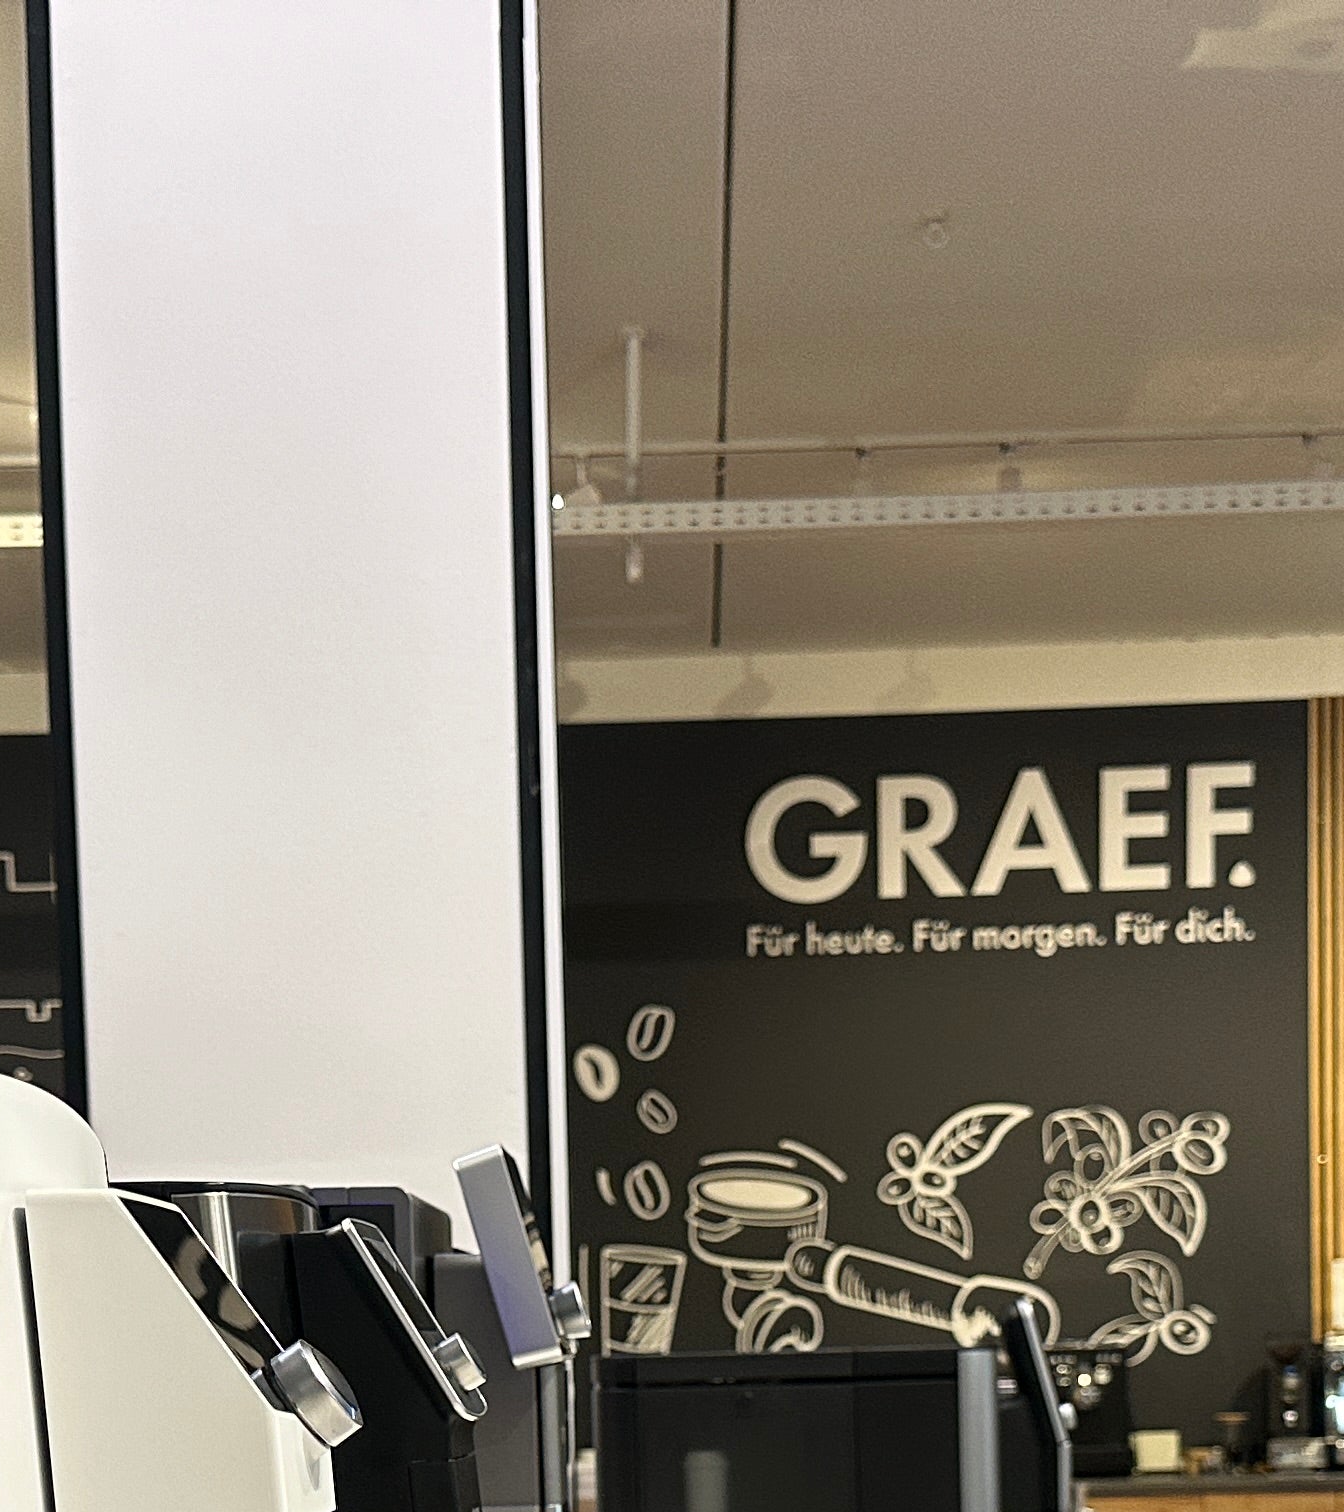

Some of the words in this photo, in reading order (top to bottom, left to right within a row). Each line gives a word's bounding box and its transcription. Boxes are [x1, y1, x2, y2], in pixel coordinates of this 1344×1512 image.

[745, 761, 1256, 904] GRAEF.
[746, 922, 800, 957] Für
[806, 919, 904, 955] heute.
[912, 918, 967, 953] Für
[972, 922, 1107, 958] morgen.
[1115, 910, 1171, 946] Für
[1175, 904, 1256, 944] dich.
